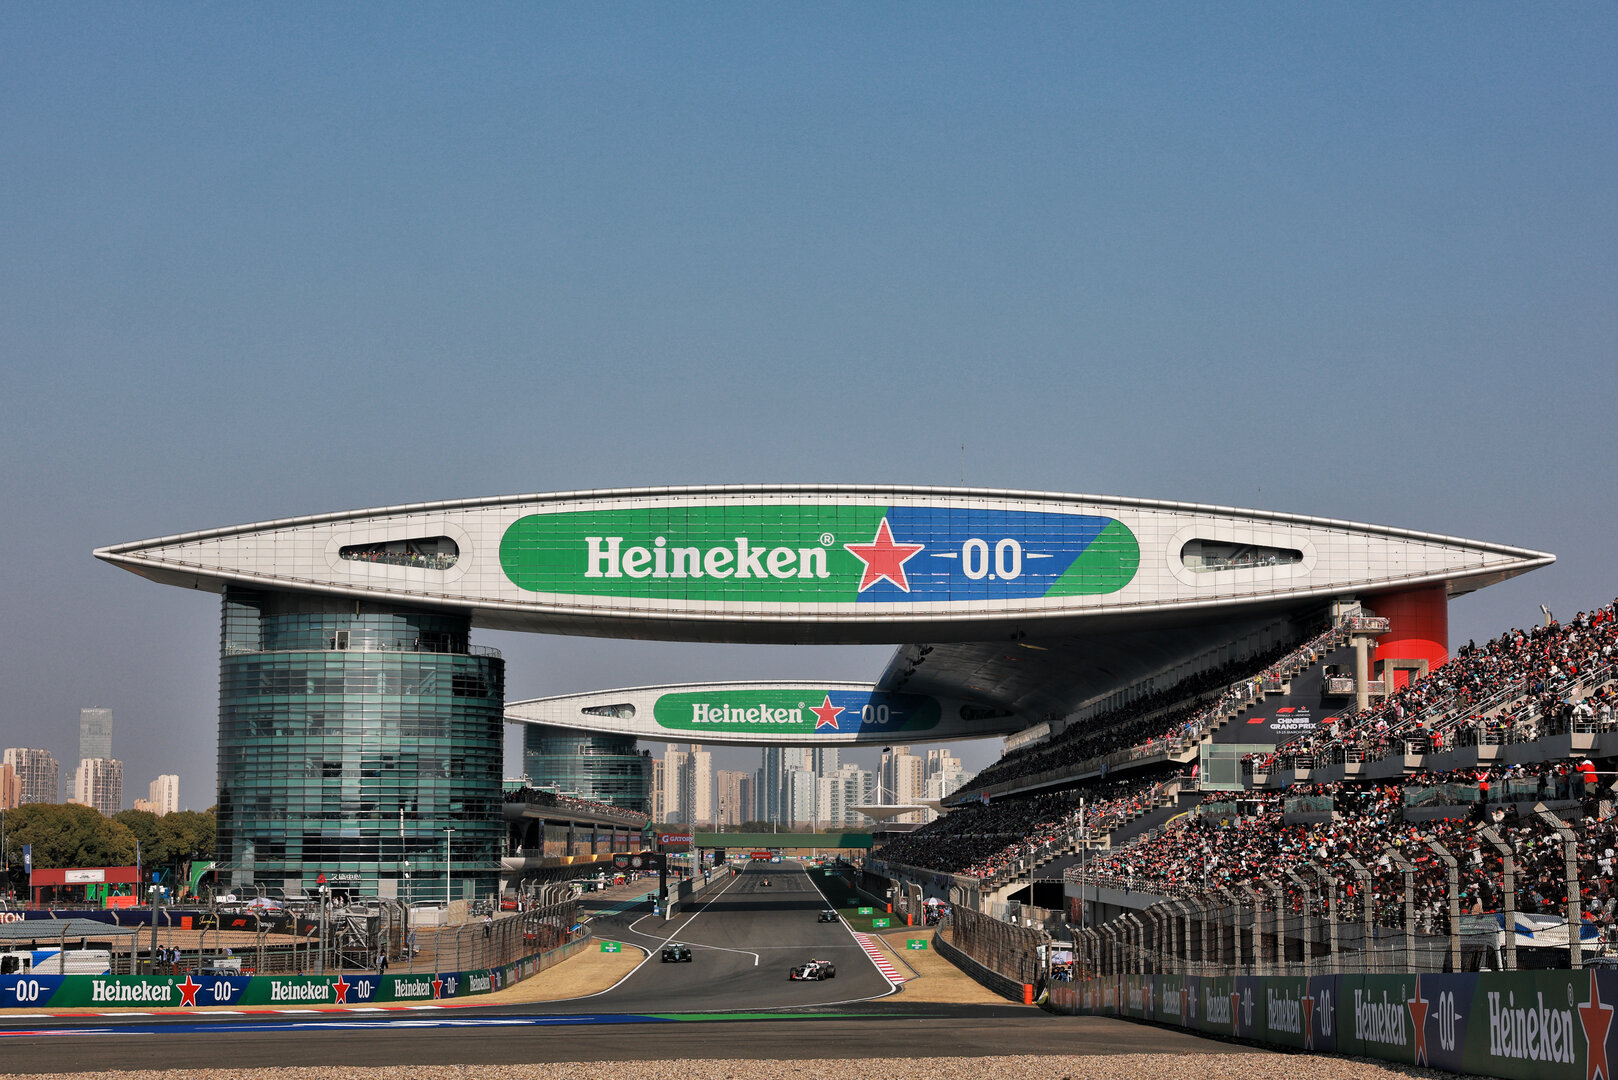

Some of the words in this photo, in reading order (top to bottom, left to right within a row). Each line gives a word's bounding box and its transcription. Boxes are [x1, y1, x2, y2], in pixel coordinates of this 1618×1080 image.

[961, 538, 1022, 581] 0.0
[862, 704, 889, 724] 0.0
[16, 980, 39, 1001] 0.0
[214, 981, 232, 1001] 0.0
[358, 980, 370, 998] 0.0
[1320, 989, 1331, 1036] 0.0
[1439, 991, 1455, 1051] 0.0
